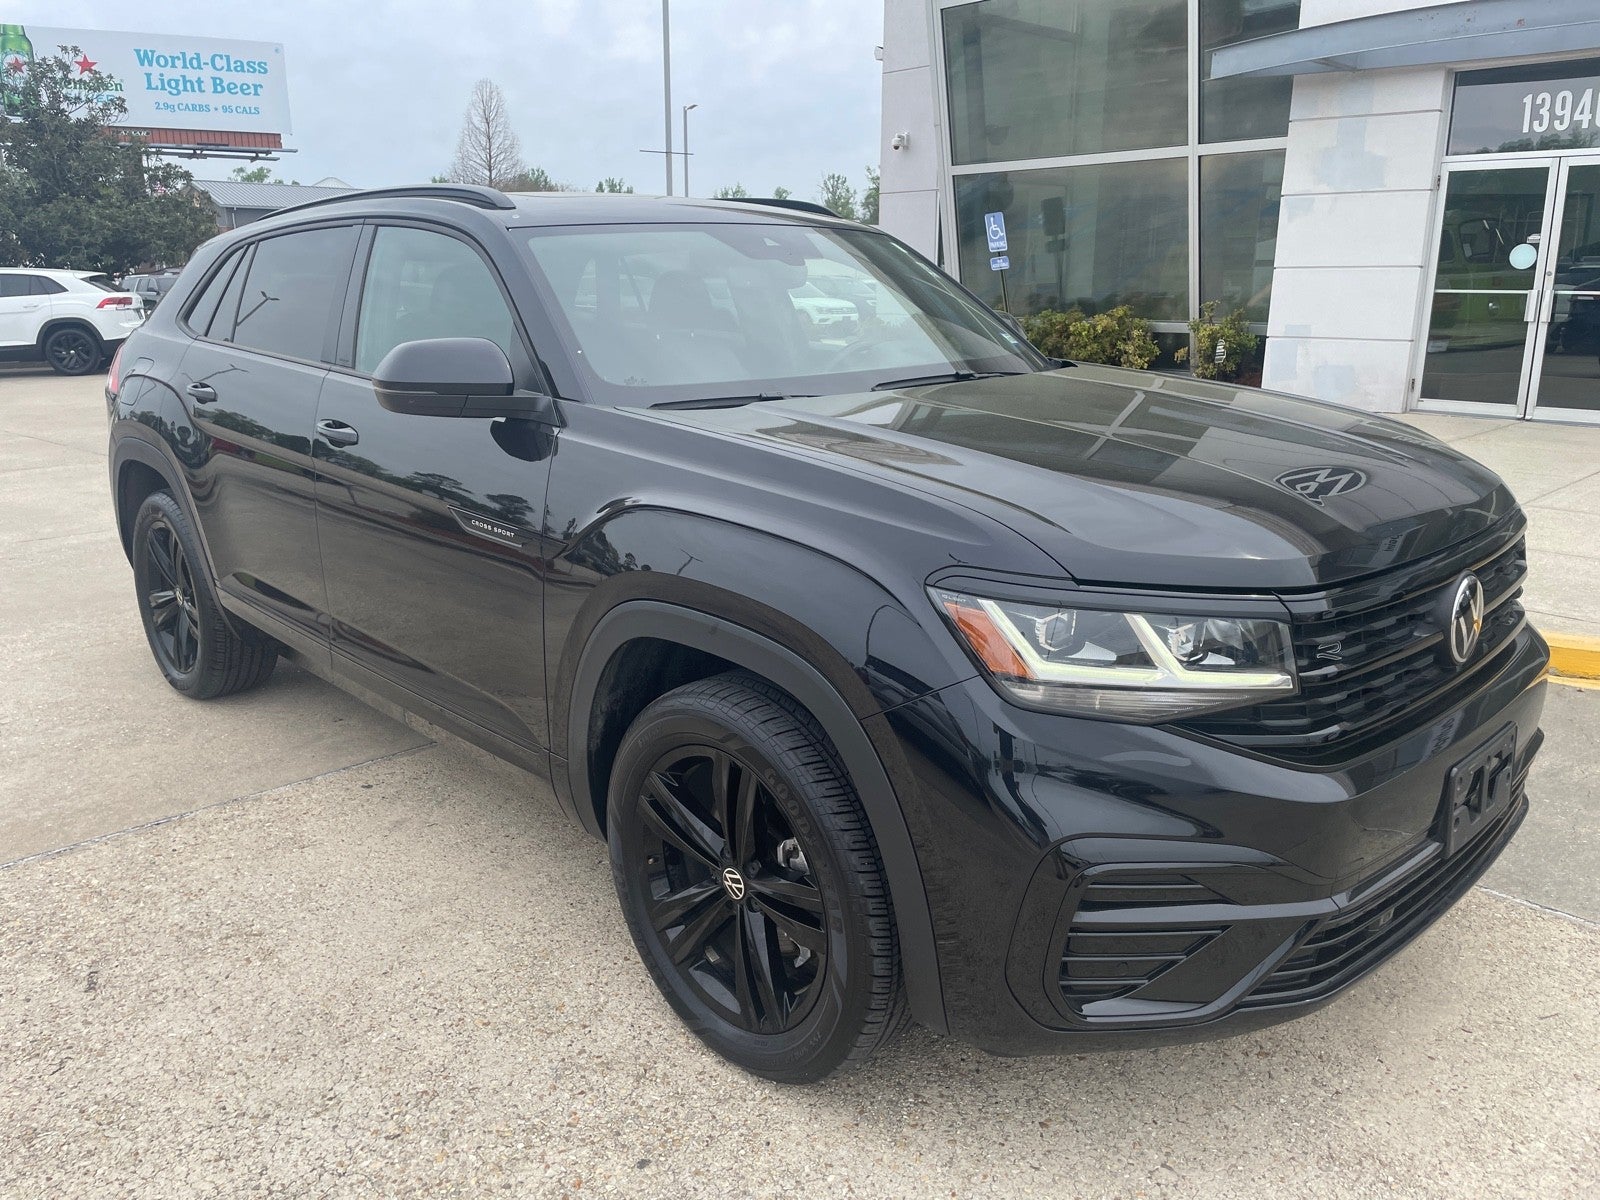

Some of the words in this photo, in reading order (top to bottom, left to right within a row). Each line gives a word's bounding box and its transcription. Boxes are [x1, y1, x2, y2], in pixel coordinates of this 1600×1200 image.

[133, 48, 269, 75] World-Class
[144, 72, 206, 96] Light
[210, 76, 264, 97] Beer
[154, 101, 176, 113] 2.9g
[177, 102, 211, 113] CARBS
[221, 105, 234, 114] 95
[234, 105, 260, 115] CALS
[471, 519, 492, 531] CROSS
[493, 526, 515, 538] SPORT
